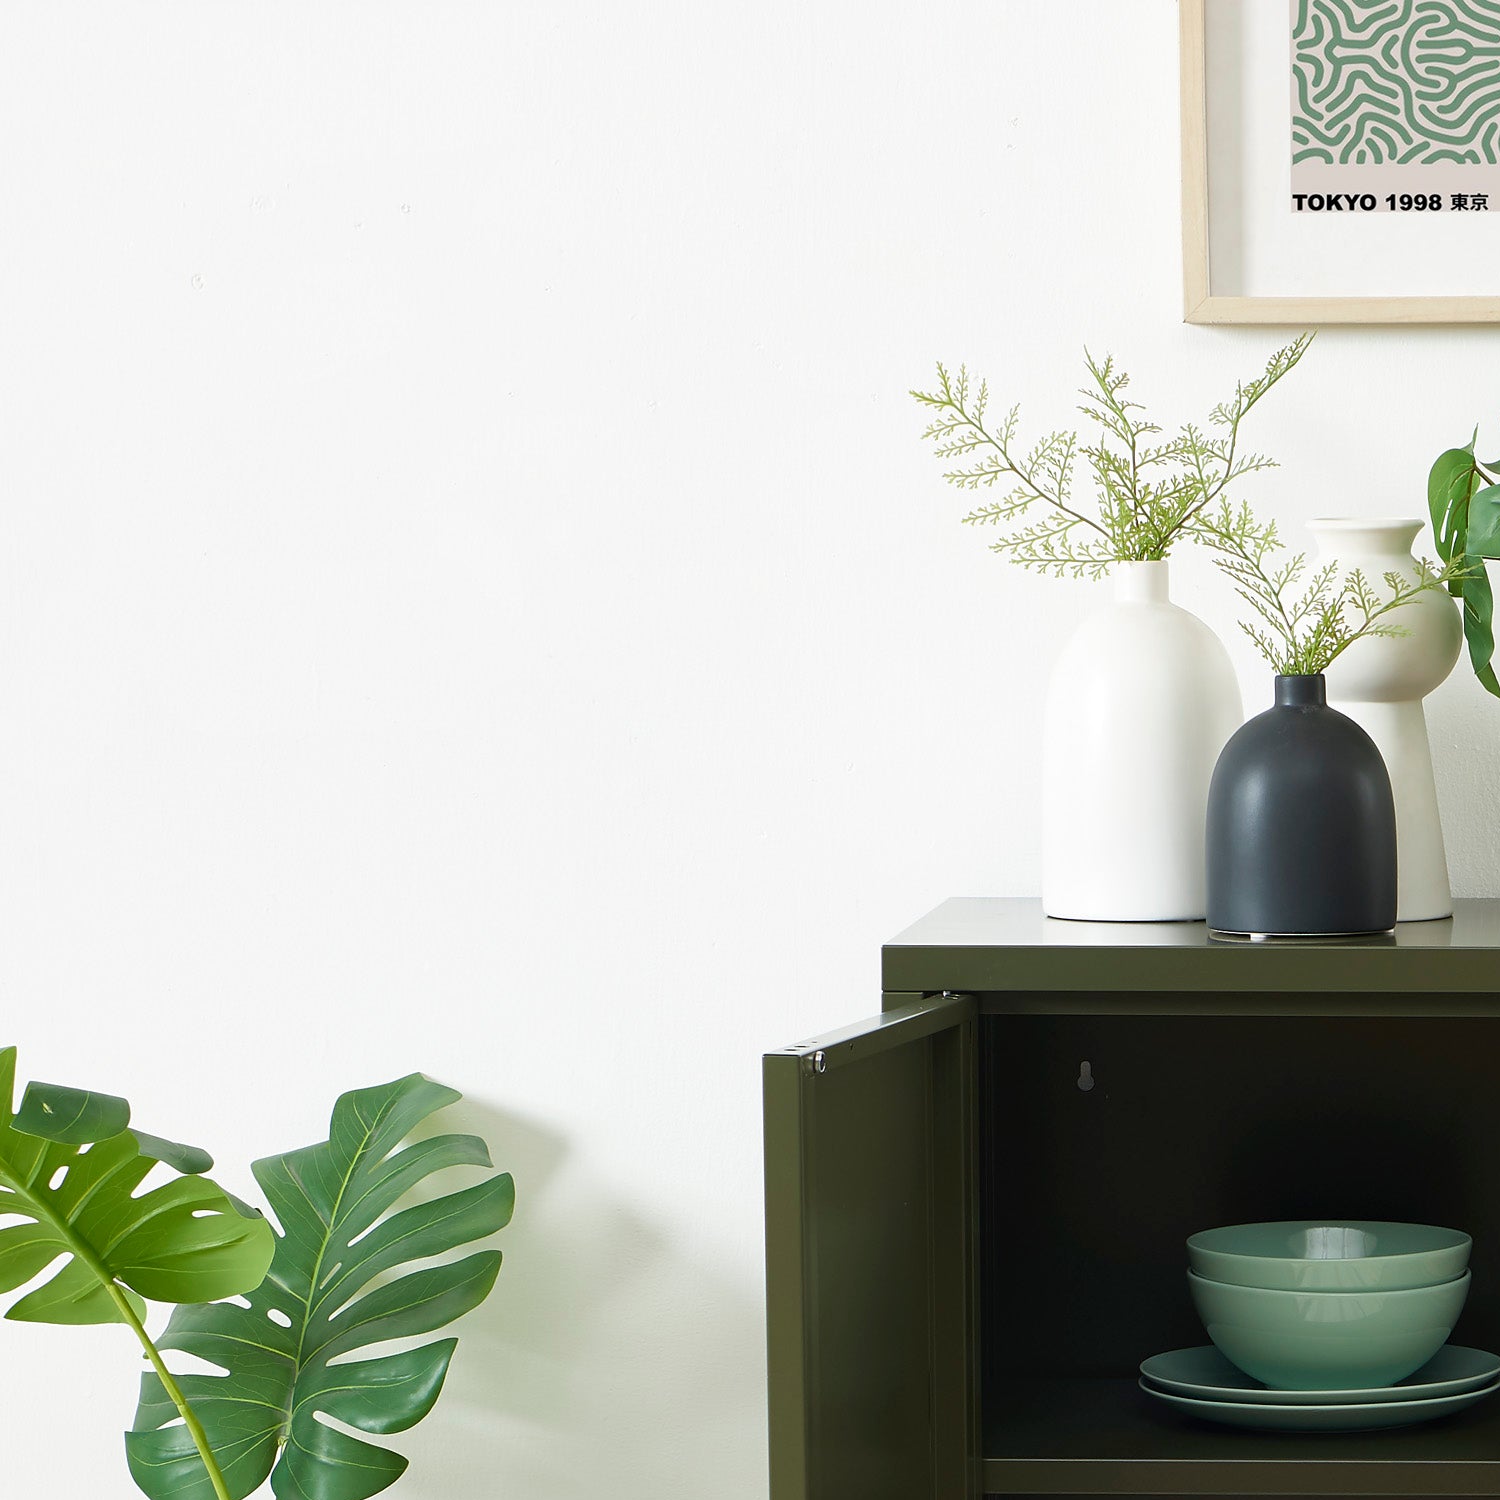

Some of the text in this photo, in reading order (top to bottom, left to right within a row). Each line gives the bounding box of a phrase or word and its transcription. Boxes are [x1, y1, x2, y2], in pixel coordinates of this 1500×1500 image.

[1292, 192, 1489, 211] TOKYO 1998 東京
